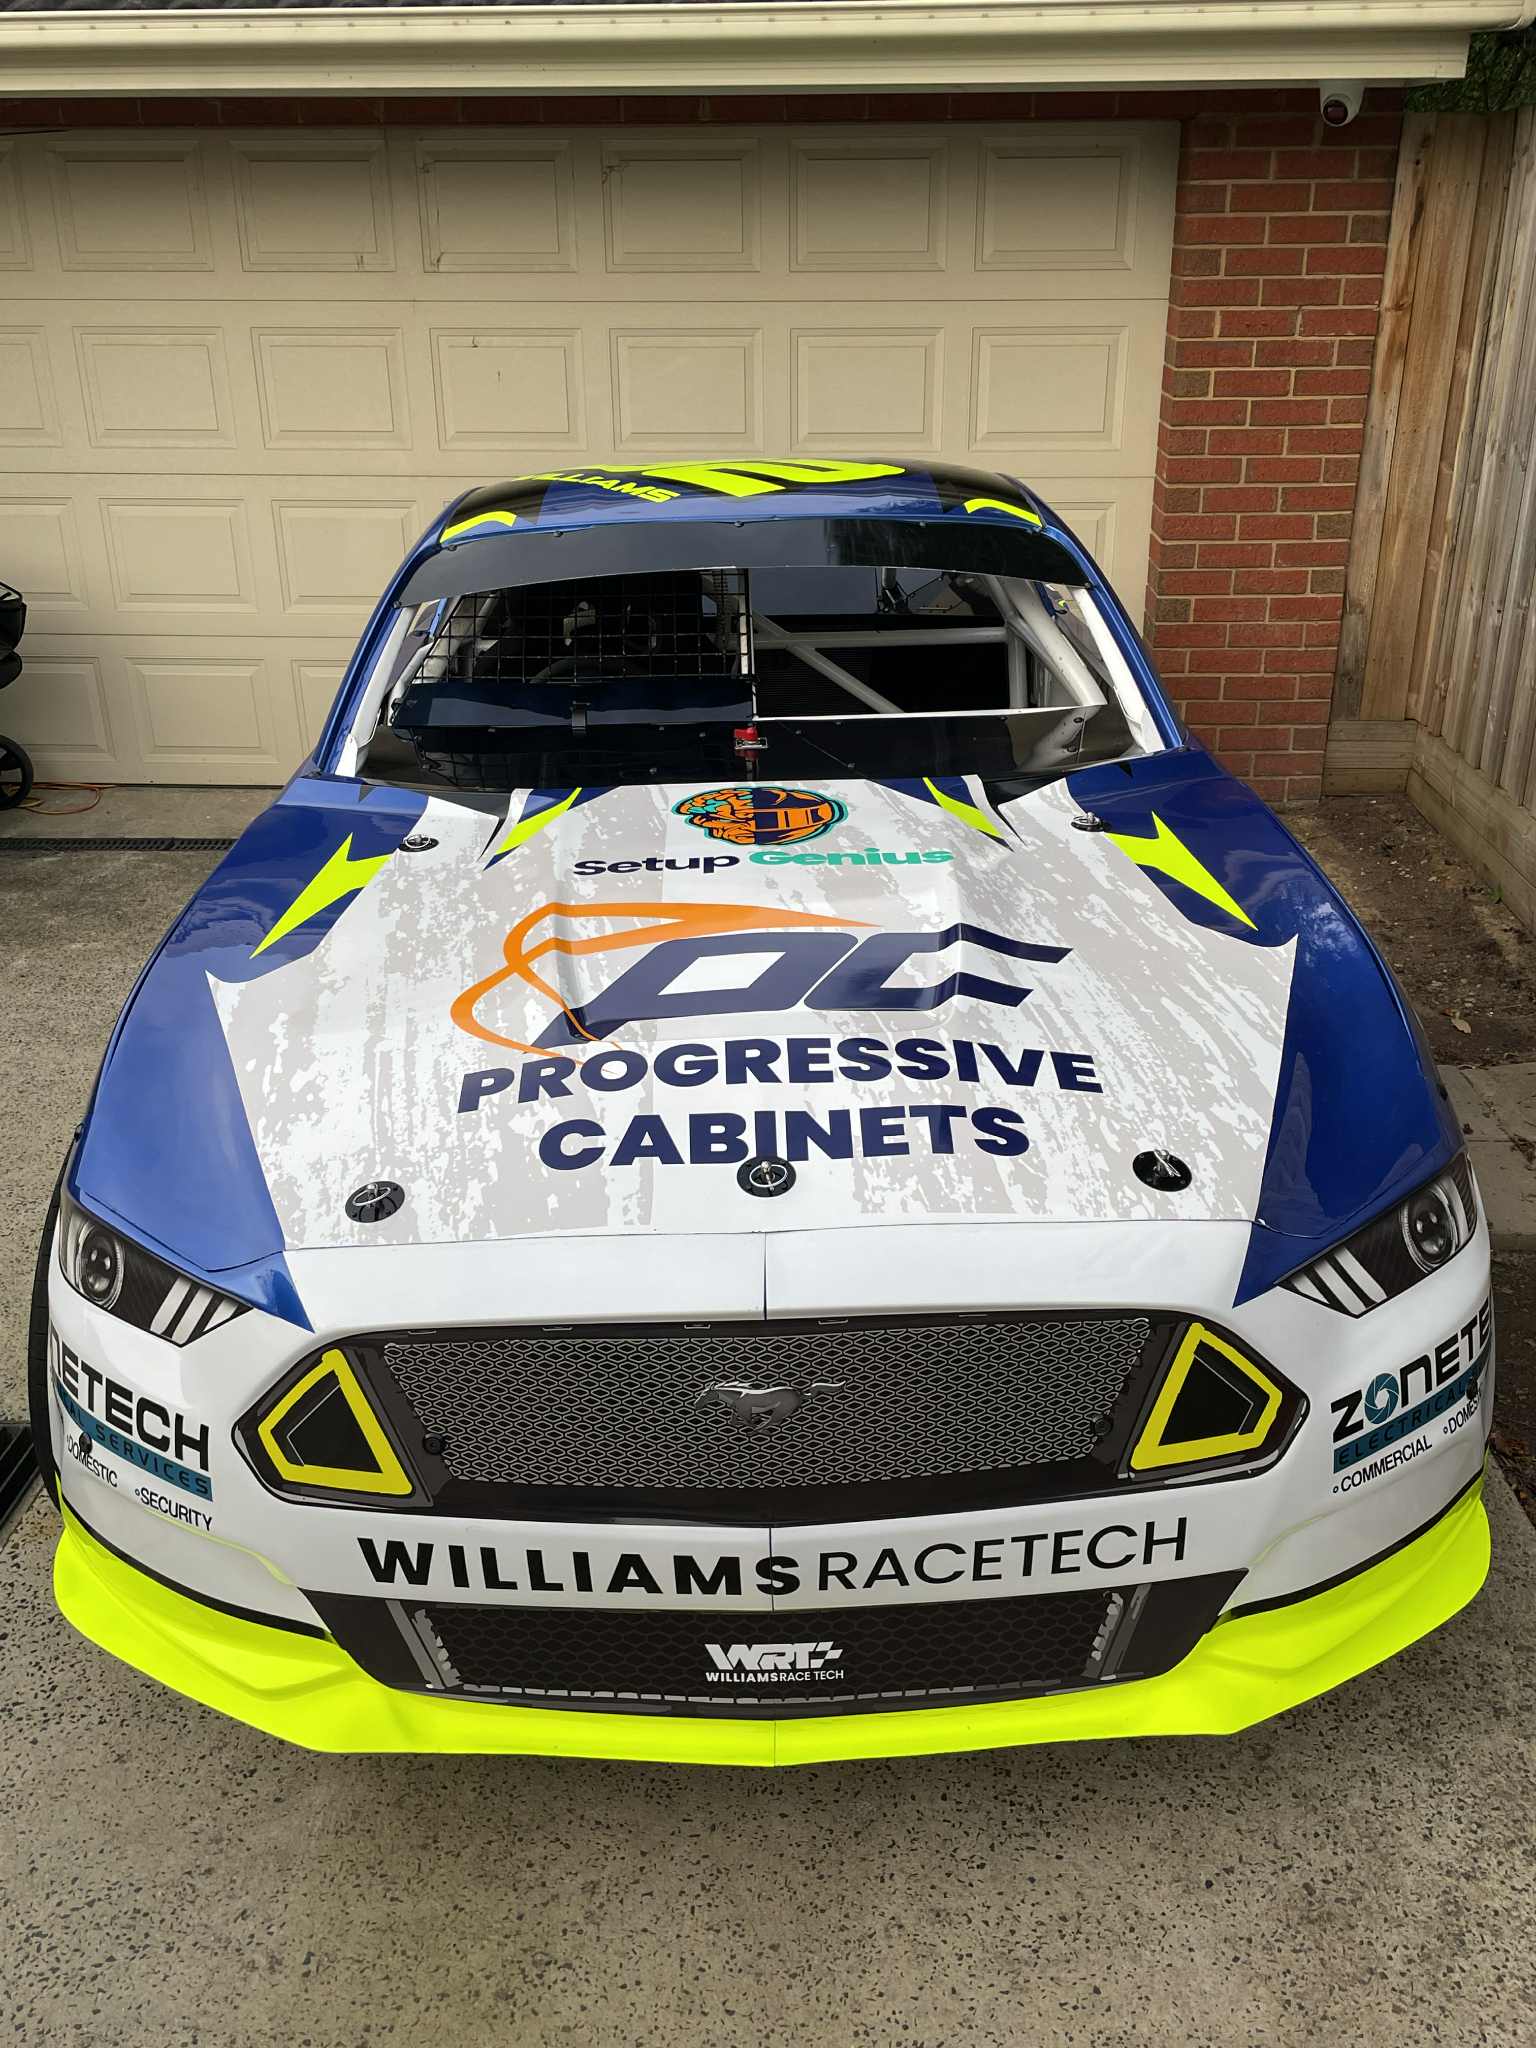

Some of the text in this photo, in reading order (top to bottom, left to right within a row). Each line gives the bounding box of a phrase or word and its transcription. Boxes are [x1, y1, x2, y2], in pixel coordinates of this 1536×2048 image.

[511, 473, 681, 503] LLIAMS
[573, 847, 954, 875] Setup Genius
[457, 1037, 1104, 1113] PROGRESSIVE
[538, 1105, 1030, 1171] CABINETS
[68, 1435, 213, 1532] DOMESTIC SECURITY
[96, 1424, 209, 1494] SERVICES
[1341, 1435, 1432, 1492] COMMERCIAL
[704, 1642, 817, 1670] WRT
[813, 1670, 844, 1680] TECH
